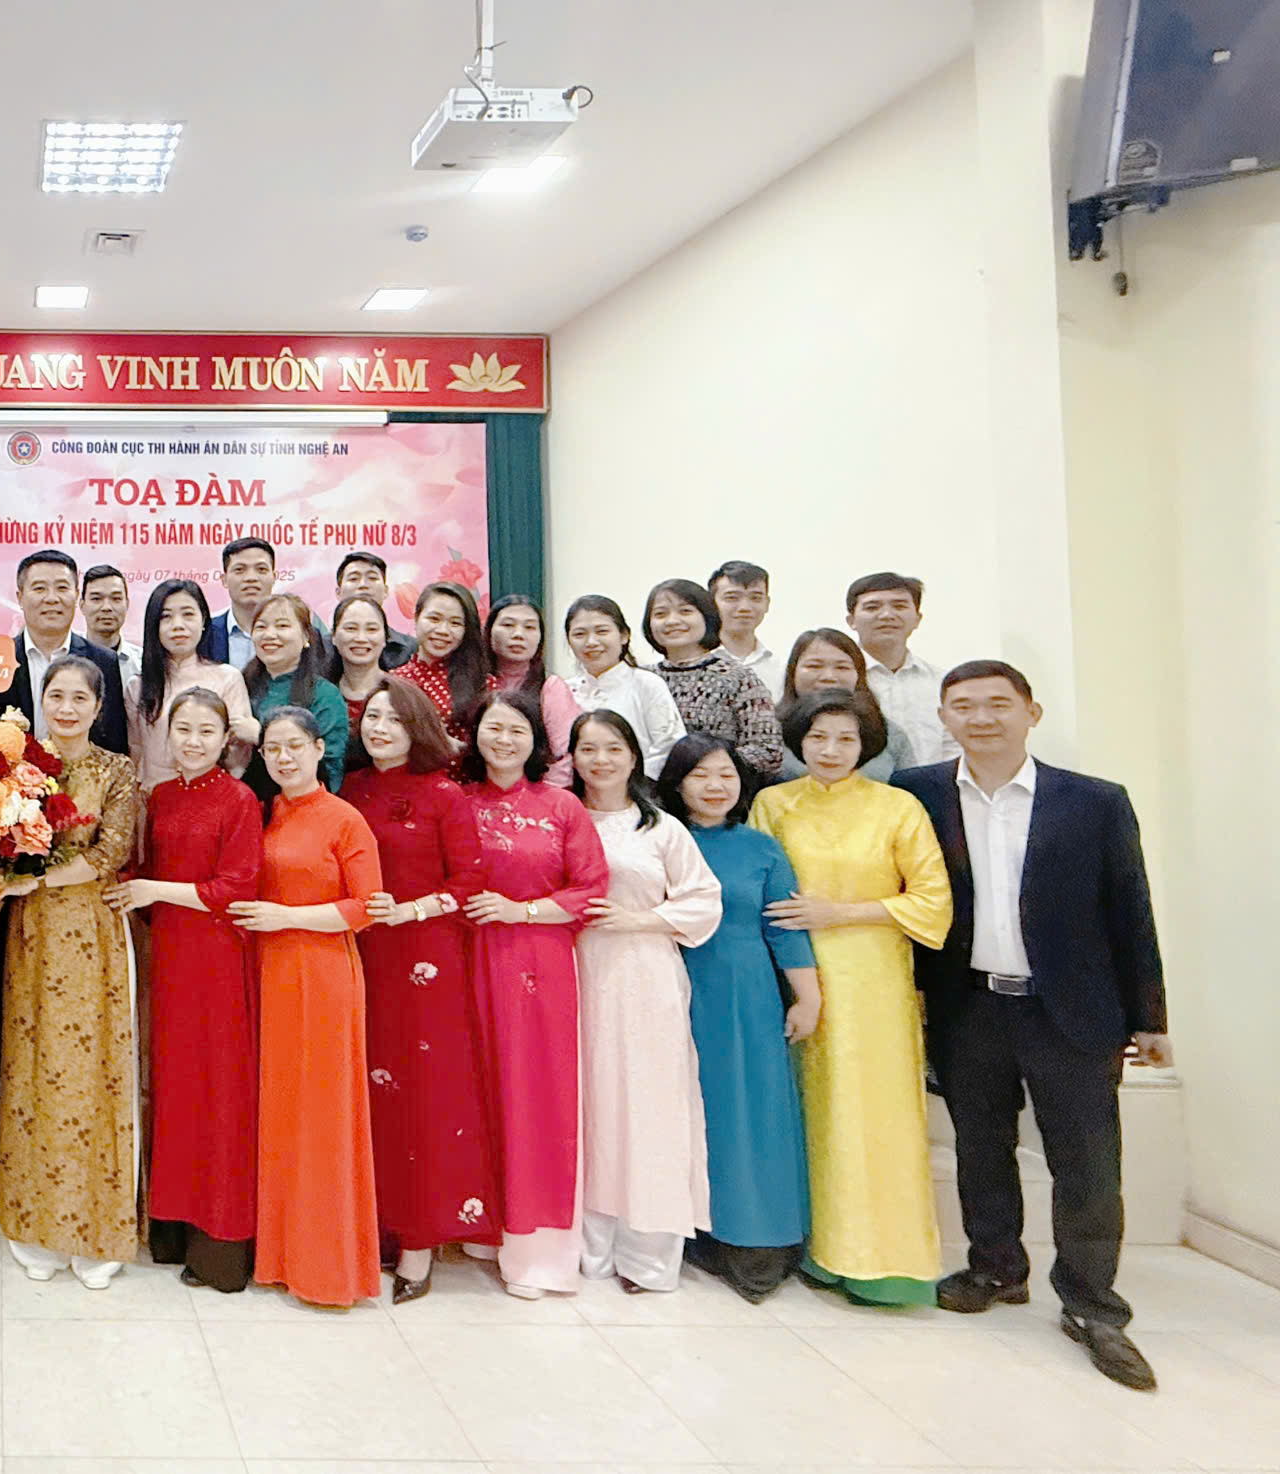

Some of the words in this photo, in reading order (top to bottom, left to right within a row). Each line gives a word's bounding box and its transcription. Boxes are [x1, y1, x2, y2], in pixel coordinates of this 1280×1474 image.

[96, 355, 200, 391] VINH
[211, 347, 328, 391] MUÔN
[337, 347, 429, 392] NĂM
[52, 439, 82, 454] CÔNG
[87, 440, 118, 454] ĐOÀN
[122, 442, 144, 457] CỤC
[148, 442, 165, 454] THI
[170, 440, 200, 455] HÀNH
[204, 440, 219, 455] ÁN
[223, 440, 247, 455] DÂN
[250, 441, 267, 457] SỰ
[269, 438, 295, 455] TỈNH
[299, 441, 329, 458] NGHỆ
[332, 443, 348, 455] AN
[89, 478, 166, 513] TOẠ
[175, 473, 266, 506] ĐÀM
[44, 515, 65, 544] KỶ
[71, 518, 114, 549] NIỆM
[120, 523, 149, 544] 115
[155, 518, 193, 544] NĂM
[200, 518, 243, 544] NGÀY
[250, 515, 294, 545] QUỐC
[299, 516, 318, 545] TẾ
[324, 524, 356, 550] PHỤ
[363, 520, 387, 545] NỮ
[391, 524, 417, 546] 8/3
[154, 570, 171, 580] 07
[174, 568, 209, 583] tháng
